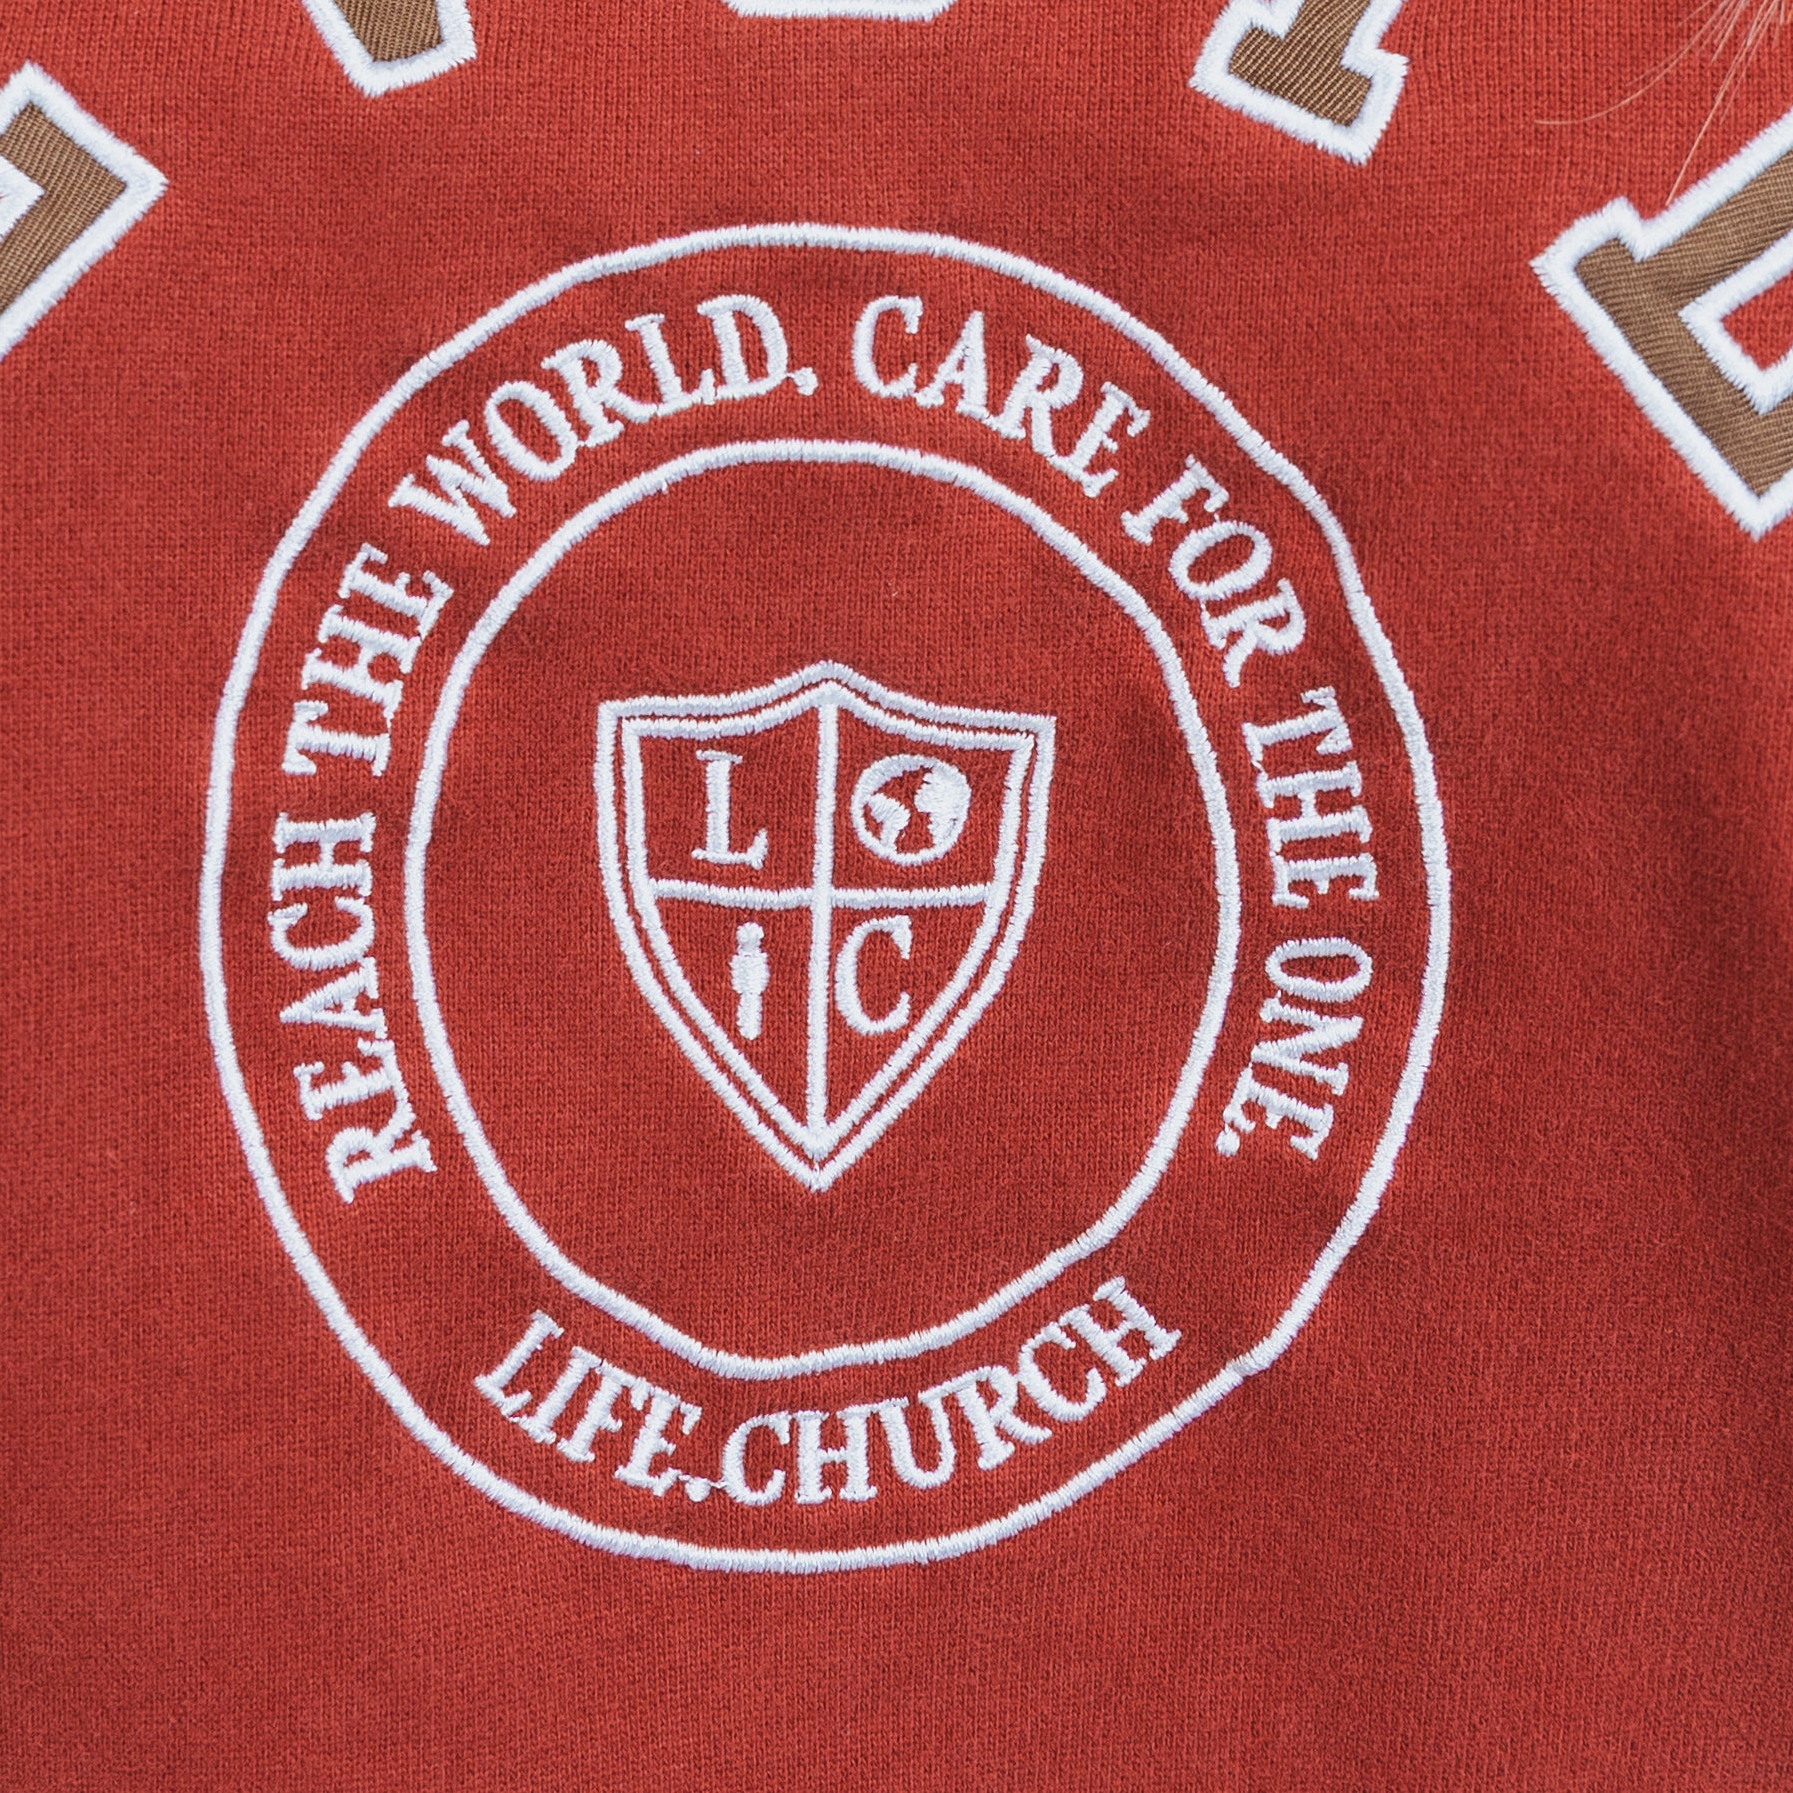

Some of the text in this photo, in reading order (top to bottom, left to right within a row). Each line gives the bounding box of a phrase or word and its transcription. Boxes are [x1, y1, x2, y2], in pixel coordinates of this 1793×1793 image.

[265, 292, 1381, 1205] REACH THE WORLD. CARE FOR THE ONE.
[689, 747, 770, 872] L
[831, 913, 913, 1040] C
[472, 1274, 1184, 1508] LIFE.CHURCH
